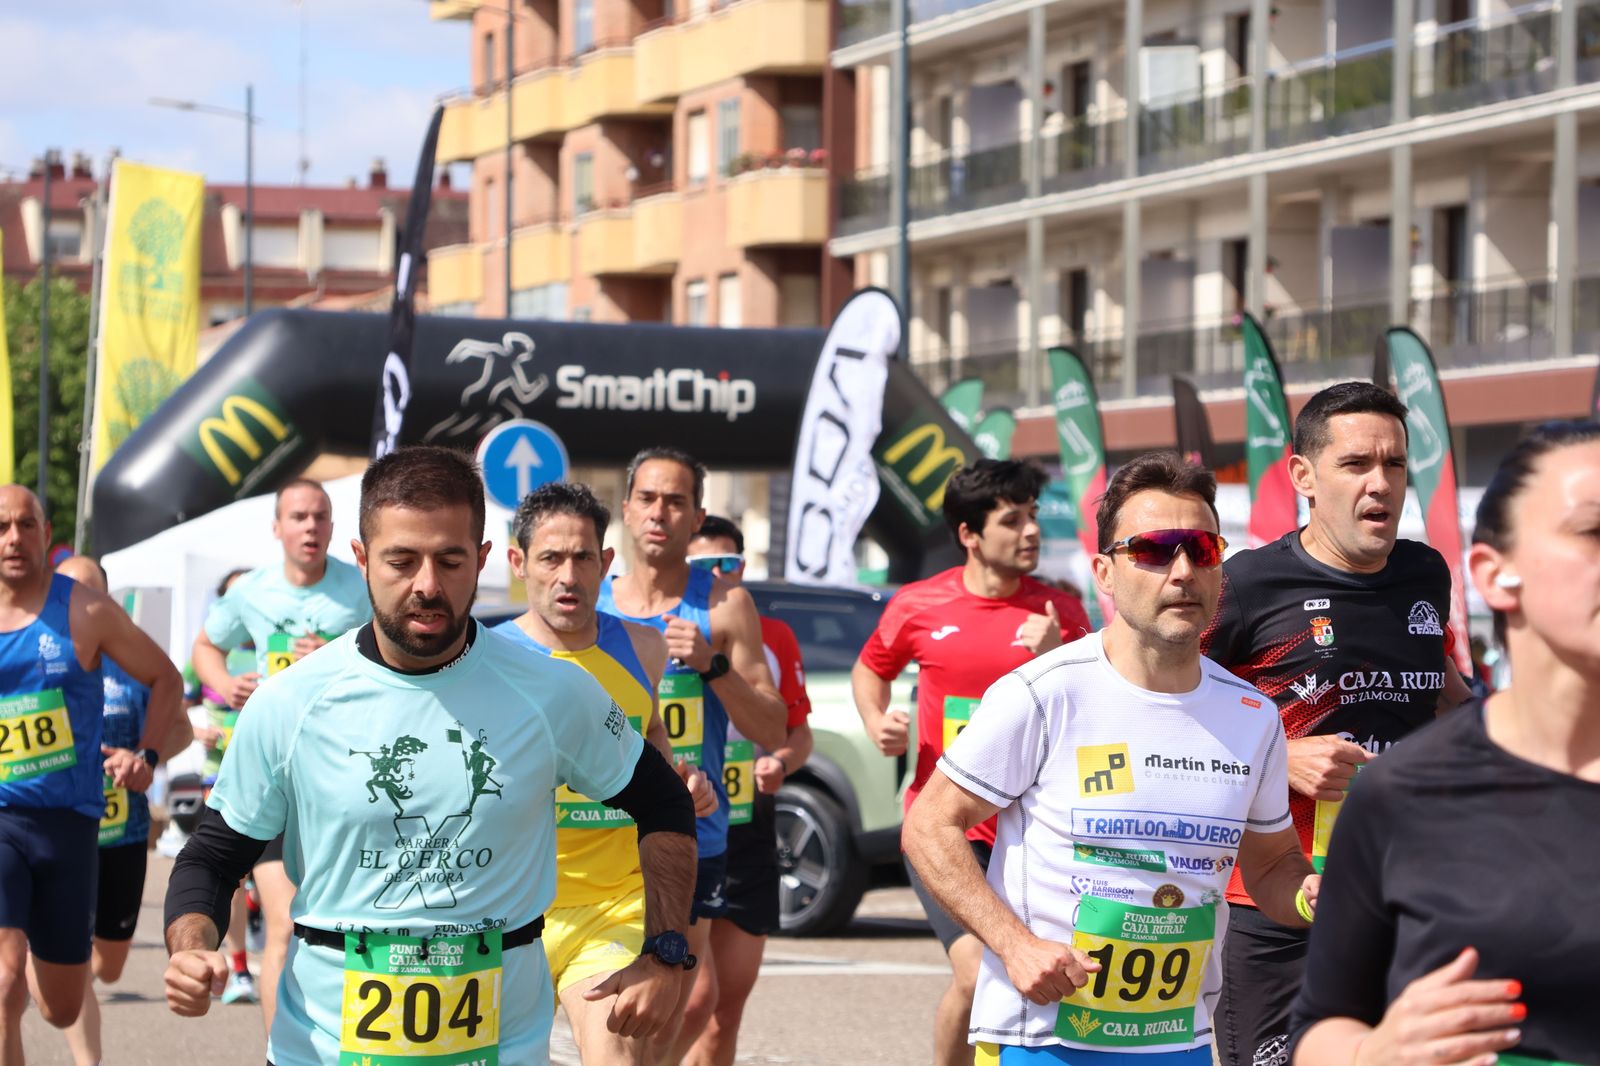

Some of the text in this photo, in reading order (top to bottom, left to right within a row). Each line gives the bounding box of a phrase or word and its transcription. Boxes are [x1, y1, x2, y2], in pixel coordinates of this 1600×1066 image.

[556, 364, 756, 422] SmartChip
[1339, 671, 1394, 691] CAJA
[1340, 690, 1410, 705] DE ZAMORA
[664, 704, 686, 738] 0
[0, 716, 57, 755] 218
[1145, 754, 1250, 776] Martín Peña
[725, 767, 740, 797] 8
[570, 810, 600, 821] CAJA
[1083, 817, 1242, 845] TRIATLON DUERO
[395, 838, 460, 849] CARRERA
[358, 848, 493, 869] EL CERCO
[1096, 848, 1163, 864] CAJA RURAL
[1108, 858, 1140, 866] ZAMORA
[1169, 856, 1216, 871] VALDÉS
[384, 871, 465, 883] DE ZAMORA
[1092, 886, 1135, 895] BARRIGÓN
[1121, 922, 1185, 934] CAJA RURAL
[1132, 933, 1158, 941] ZAMORA
[388, 955, 464, 966] CAJA RURAL
[1088, 943, 1190, 1002] 199
[356, 978, 483, 1043] 204
[1102, 1019, 1187, 1036] CAJA RURAL
